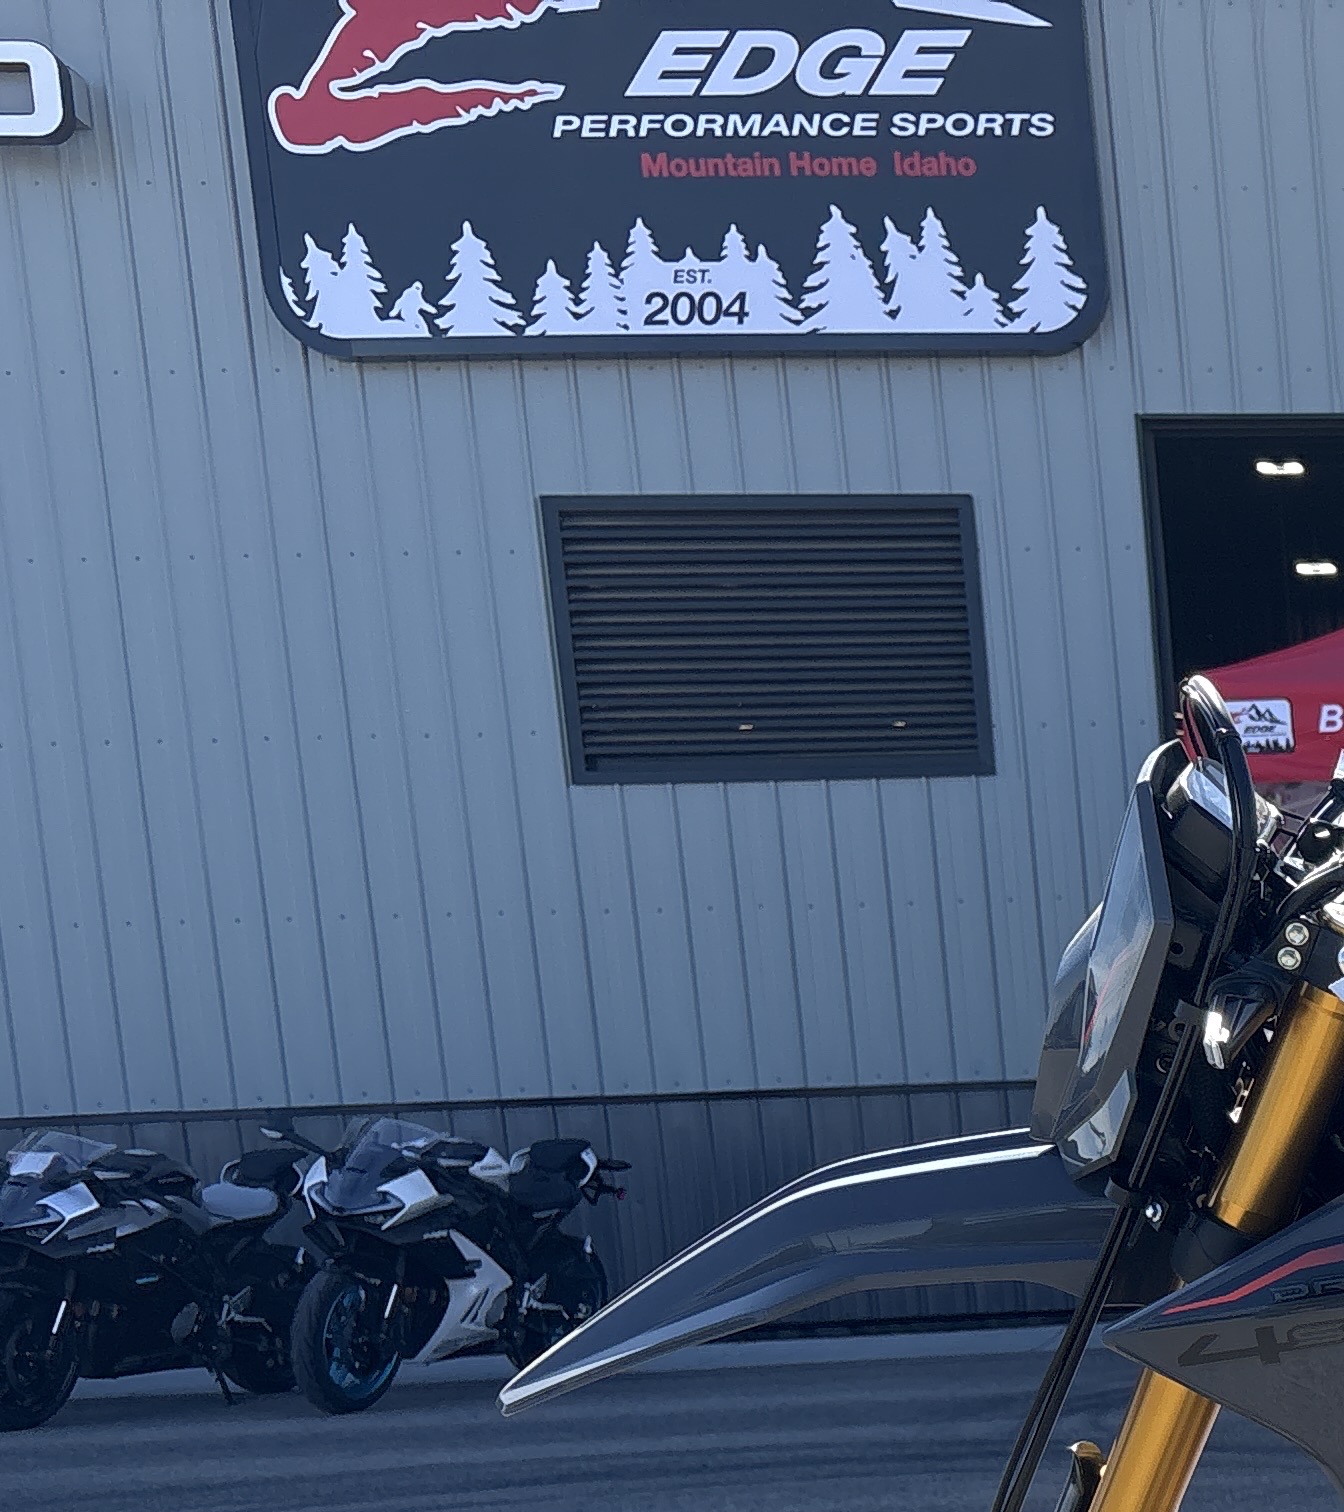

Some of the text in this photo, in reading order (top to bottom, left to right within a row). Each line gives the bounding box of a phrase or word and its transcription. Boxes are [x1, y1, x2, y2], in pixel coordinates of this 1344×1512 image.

[623, 28, 973, 98] EDGE
[553, 111, 1055, 138] PERFORMANCE SPORTS
[640, 151, 977, 177] Mountain Home Idaho
[673, 268, 712, 284] EST.
[643, 291, 749, 326] 2004
